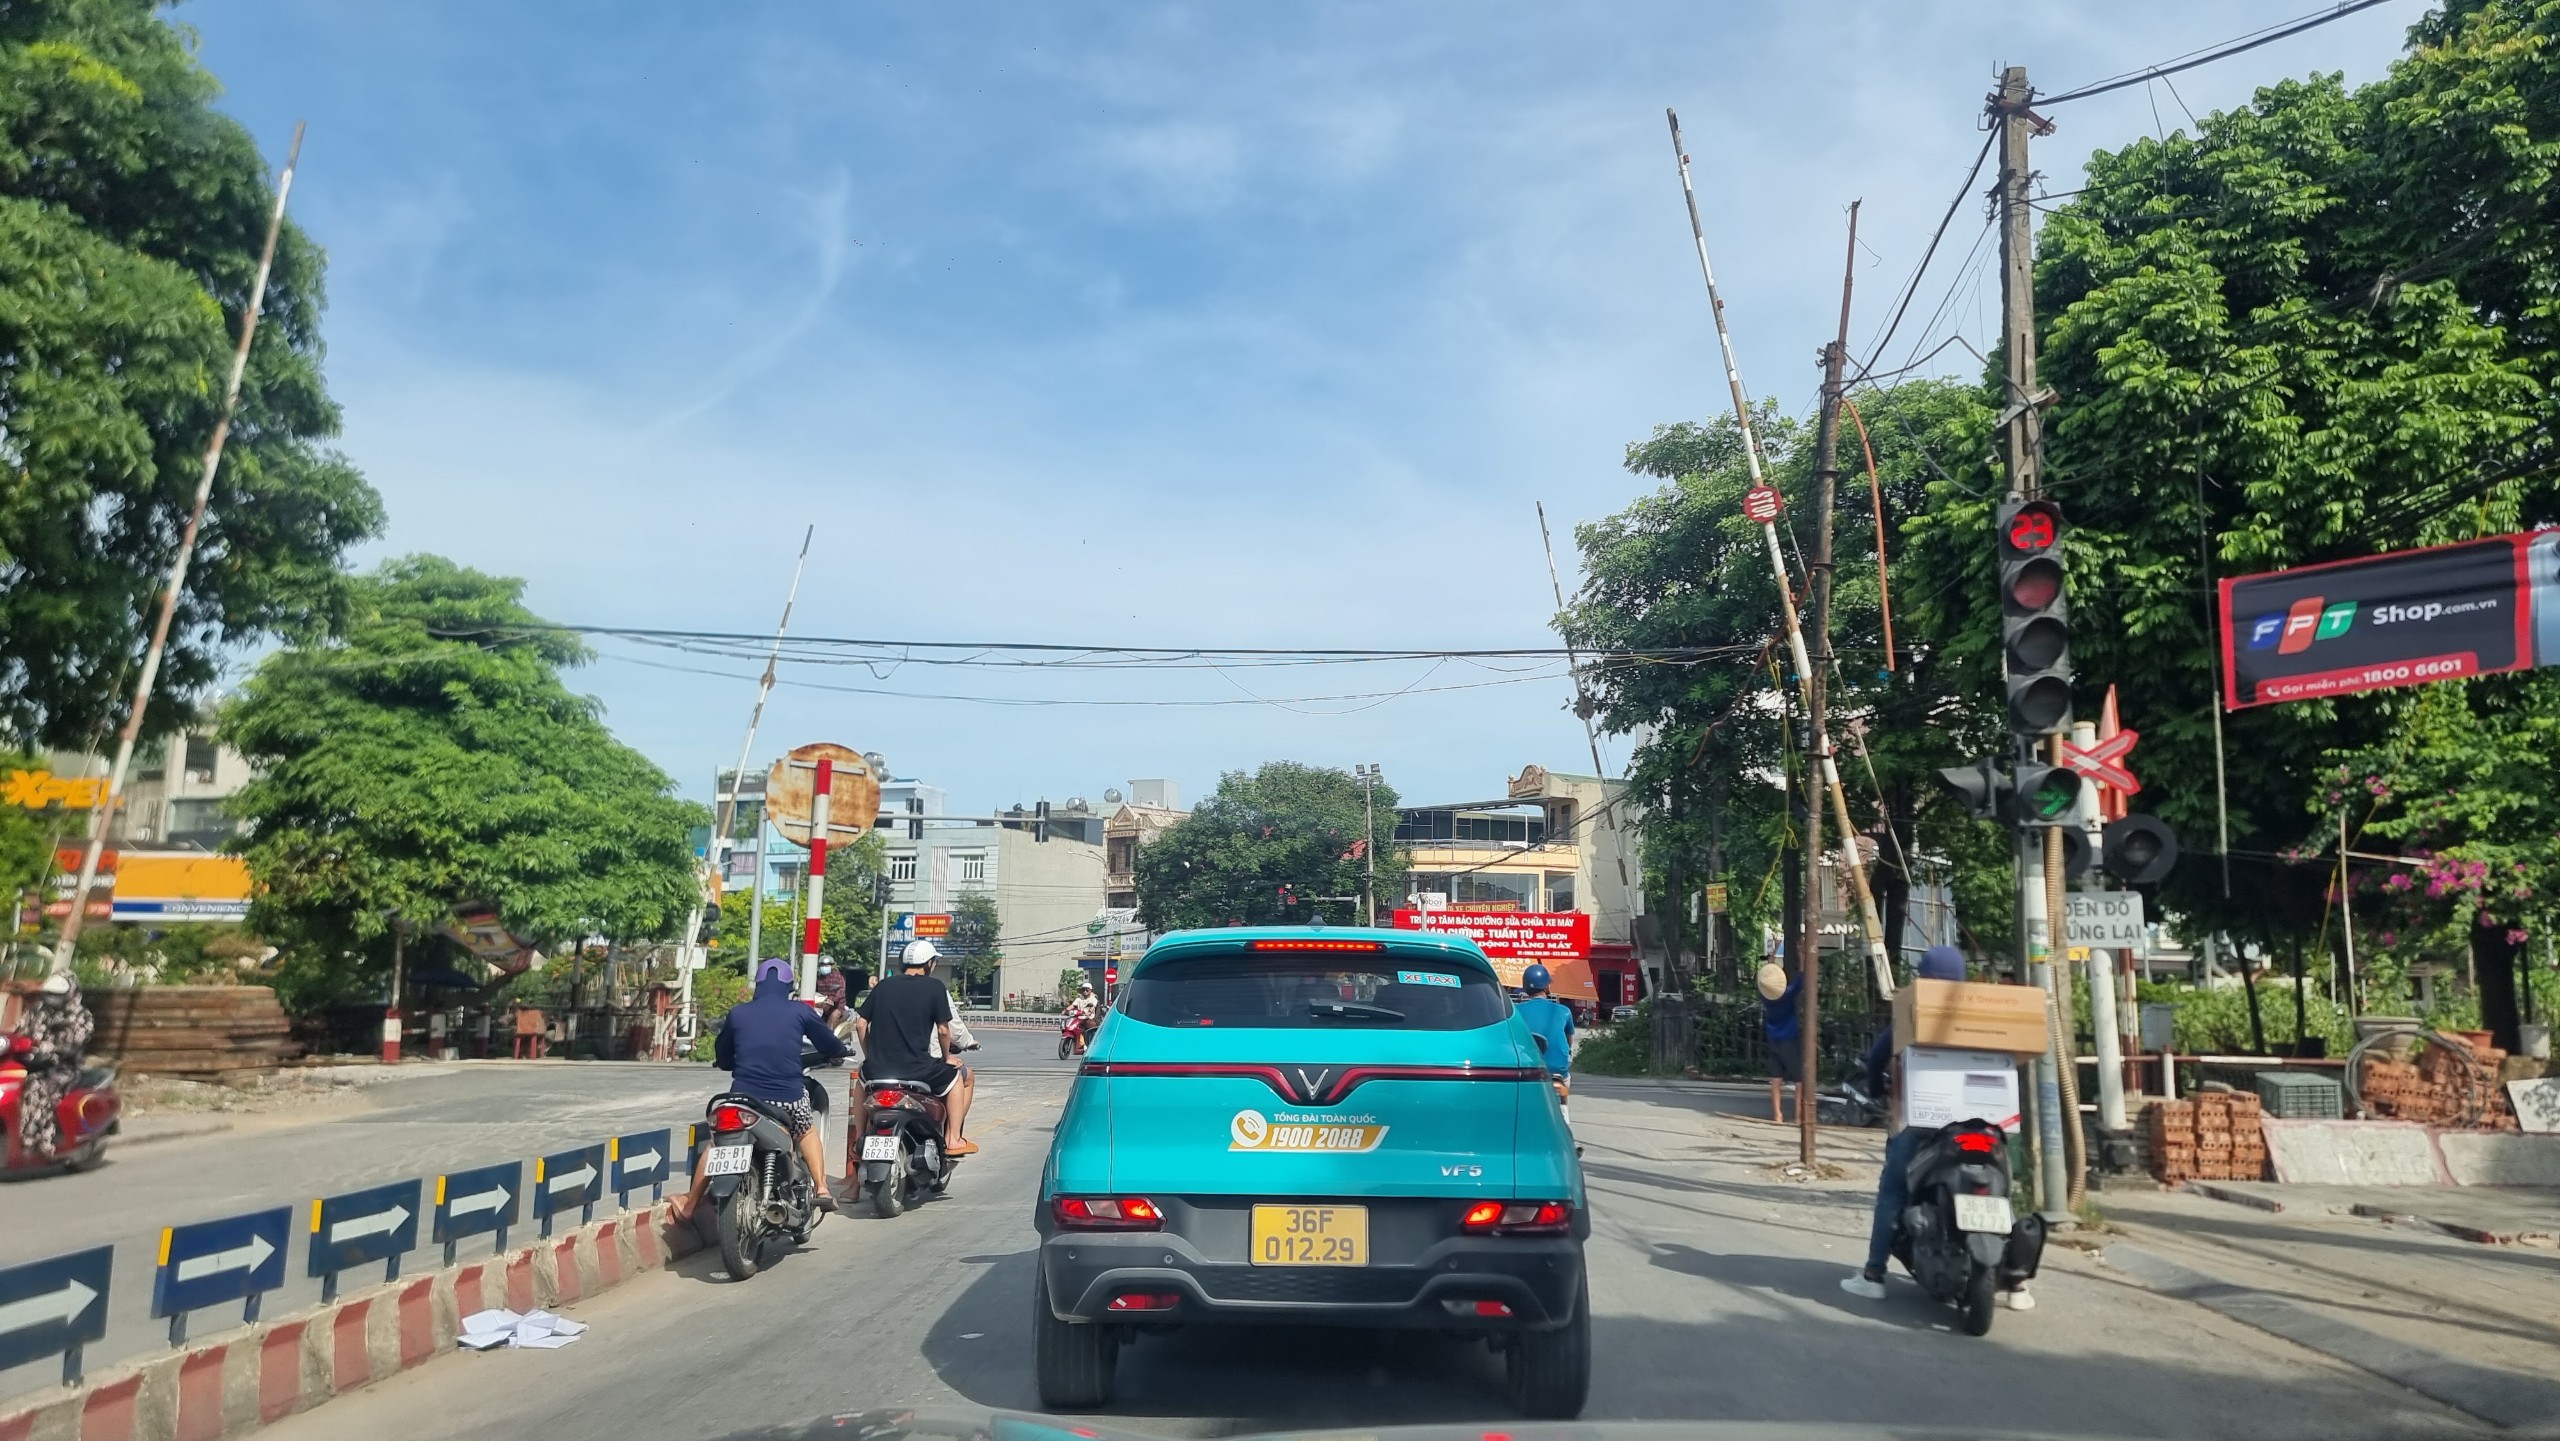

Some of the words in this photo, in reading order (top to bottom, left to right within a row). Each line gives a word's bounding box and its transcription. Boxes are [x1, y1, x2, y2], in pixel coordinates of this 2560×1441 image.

[2010, 512, 2053, 549] 23
[2254, 612, 2352, 642] FPT
[2281, 684, 2304, 695] Gọi
[2363, 668, 2410, 684] 1800
[2414, 658, 2462, 677] 6601
[1491, 903, 1516, 913] NGHIỆP
[2105, 894, 2130, 916] ĐỎ
[1438, 914, 1454, 924] TÂM
[1546, 918, 1557, 927] XE
[1557, 917, 1574, 927] MÁY
[1551, 932, 1568, 940] GÒN
[2065, 919, 2105, 940] ỪNG
[2112, 924, 2142, 945] LẠI
[1547, 940, 1573, 949] MÁY
[1404, 974, 1422, 982] XE
[1426, 975, 1456, 985] TAXI
[1274, 1111, 1301, 1123] TỔNG
[1302, 1111, 1319, 1123] ĐÀI
[1321, 1112, 1347, 1123] TOÀN
[1348, 1112, 1376, 1125] QUỐC
[870, 1137, 894, 1149] 36-B5
[1270, 1127, 1313, 1148] 1900
[1315, 1127, 1364, 1149] 2088
[714, 1147, 746, 1161] 36-B1
[865, 1148, 897, 1160] 662.63
[707, 1159, 748, 1175] 009.40
[1286, 1209, 1334, 1234] 36F
[1265, 1236, 1355, 1262] 012.29
